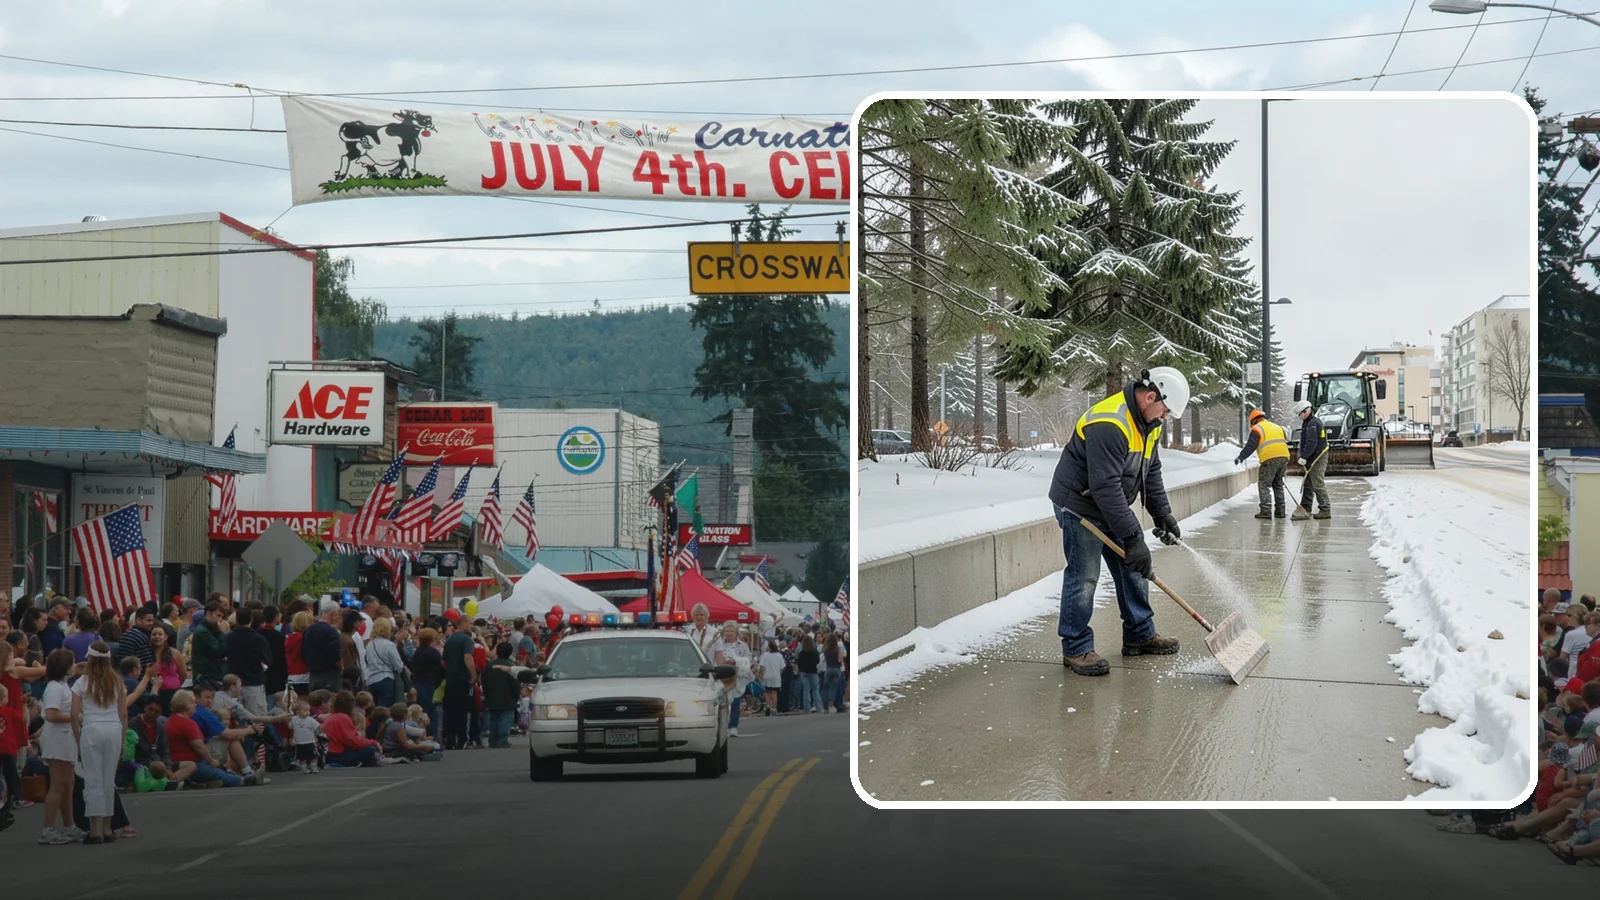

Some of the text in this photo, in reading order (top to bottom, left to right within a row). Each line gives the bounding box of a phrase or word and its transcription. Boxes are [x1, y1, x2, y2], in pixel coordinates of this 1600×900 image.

[481, 141, 604, 192] JULY
[632, 150, 746, 198] 4th.
[697, 254, 850, 279] CROSSWA
[283, 380, 373, 419] ACE
[405, 409, 453, 421] CEDAR
[283, 421, 370, 436] Hardware
[353, 467, 383, 480] Simpl
[83, 484, 155, 495] St. Vincent de Paul
[212, 516, 330, 535] HARDARE
[688, 526, 741, 535] CRNATION
[699, 535, 730, 543] GLASS
